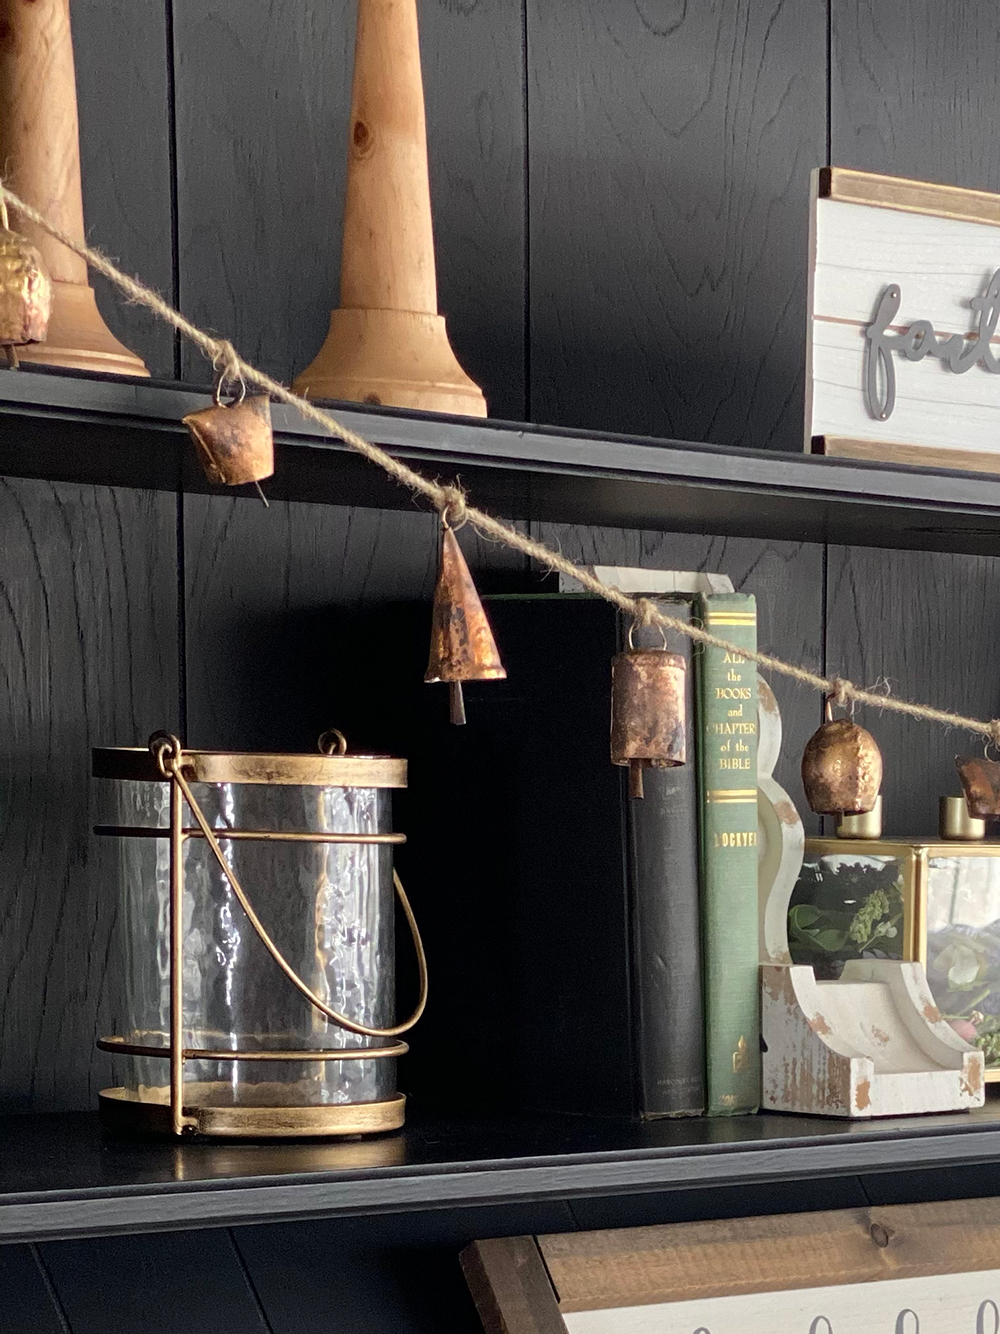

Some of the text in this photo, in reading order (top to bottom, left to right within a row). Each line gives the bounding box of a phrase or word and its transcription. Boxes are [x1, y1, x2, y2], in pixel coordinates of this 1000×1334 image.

[723, 651, 745, 664] ALL
[727, 668, 742, 682] the
[716, 687, 752, 700] BOOKS
[727, 704, 743, 717] and
[720, 739, 749, 752] of the
[720, 758, 750, 770] BIBLE
